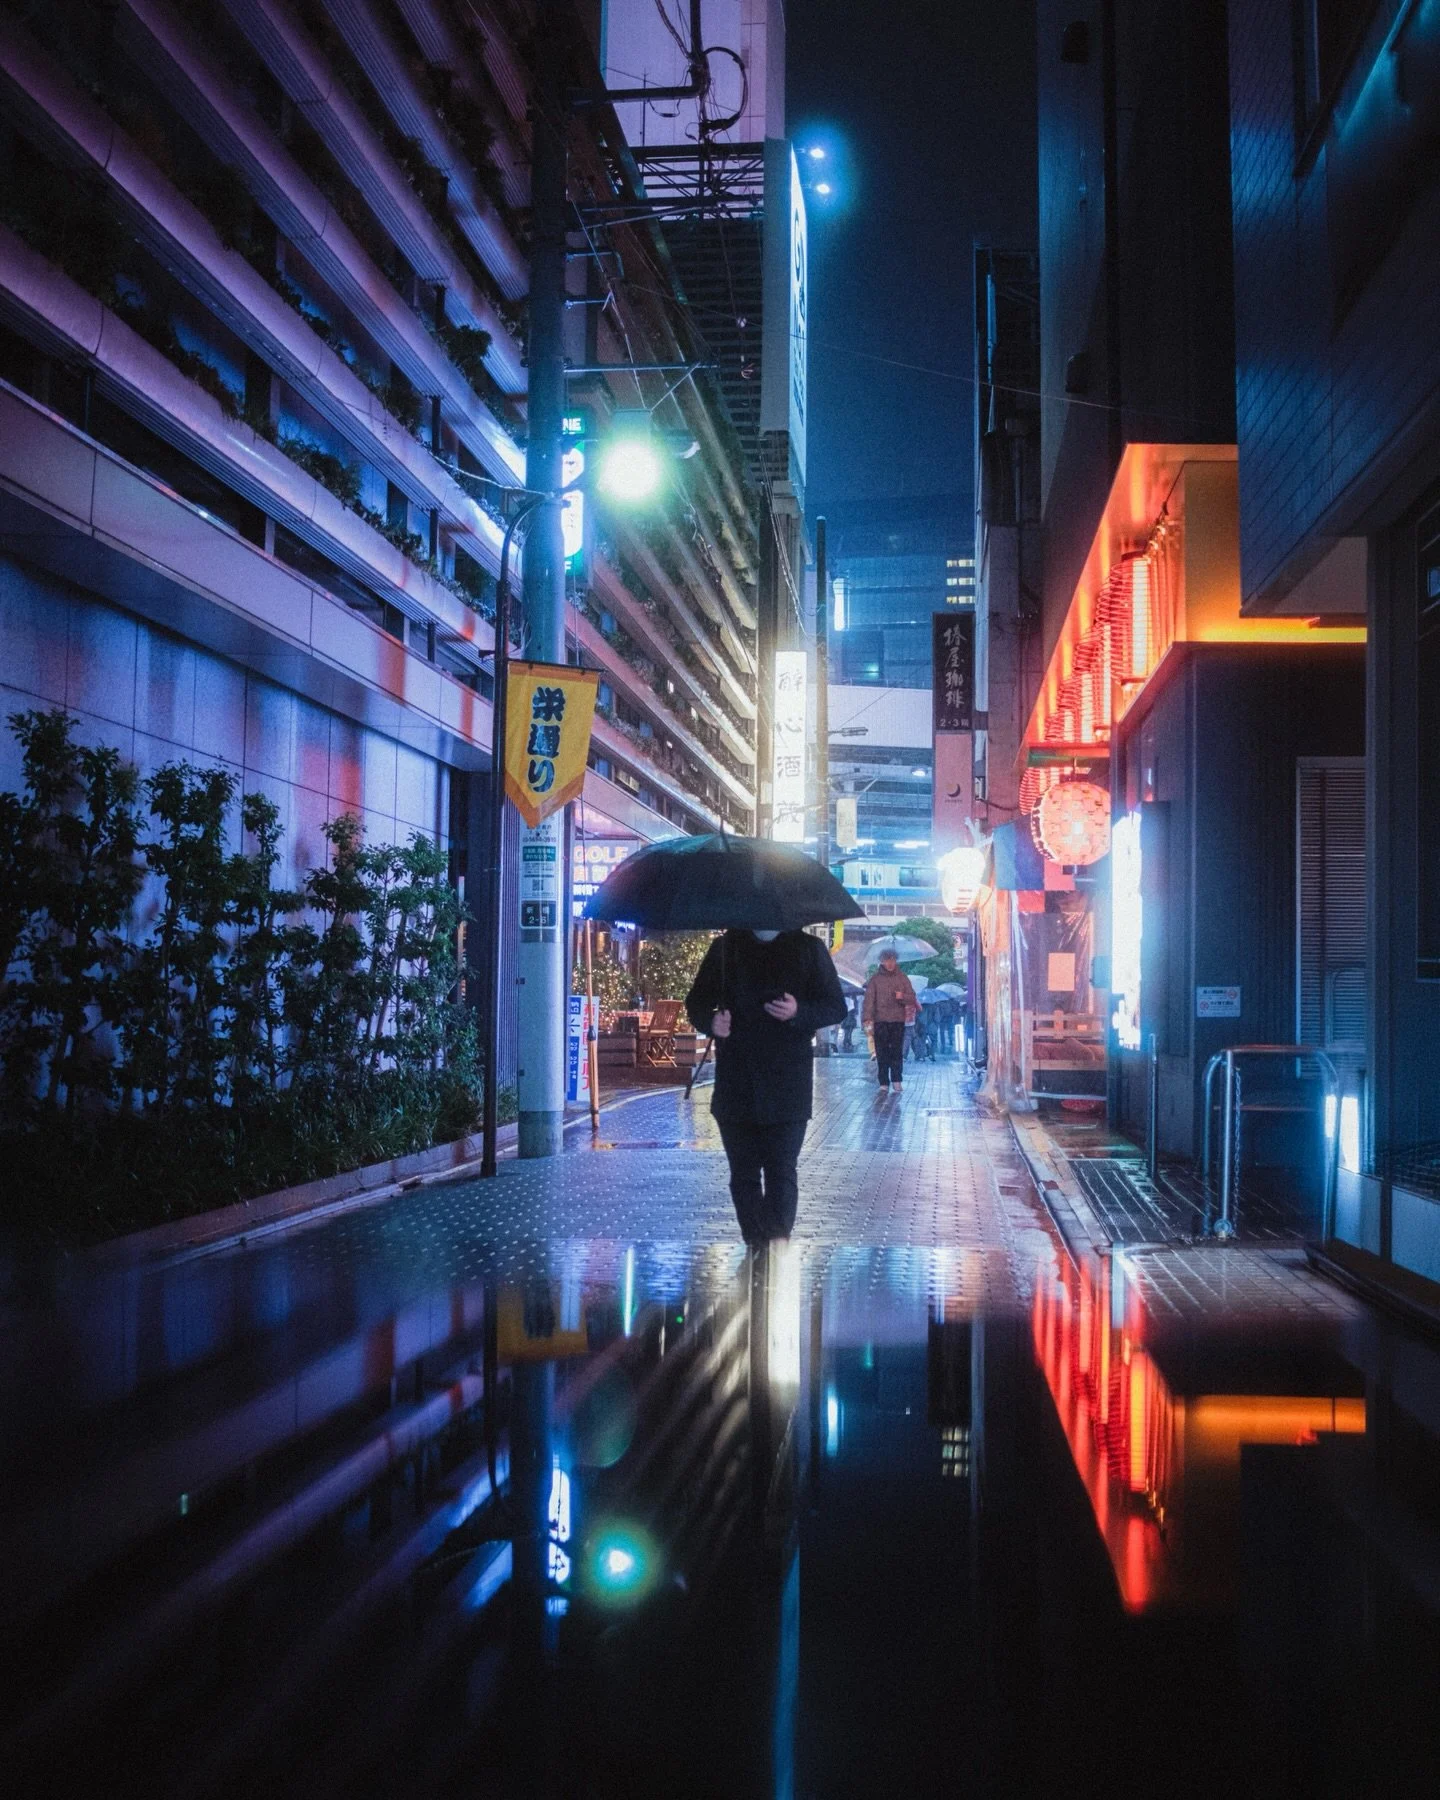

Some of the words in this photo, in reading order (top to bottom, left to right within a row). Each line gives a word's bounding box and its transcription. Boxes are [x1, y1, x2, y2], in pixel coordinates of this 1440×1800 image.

[943, 623, 967, 709] 椿屋珈琲
[527, 686, 566, 793] 栄通り
